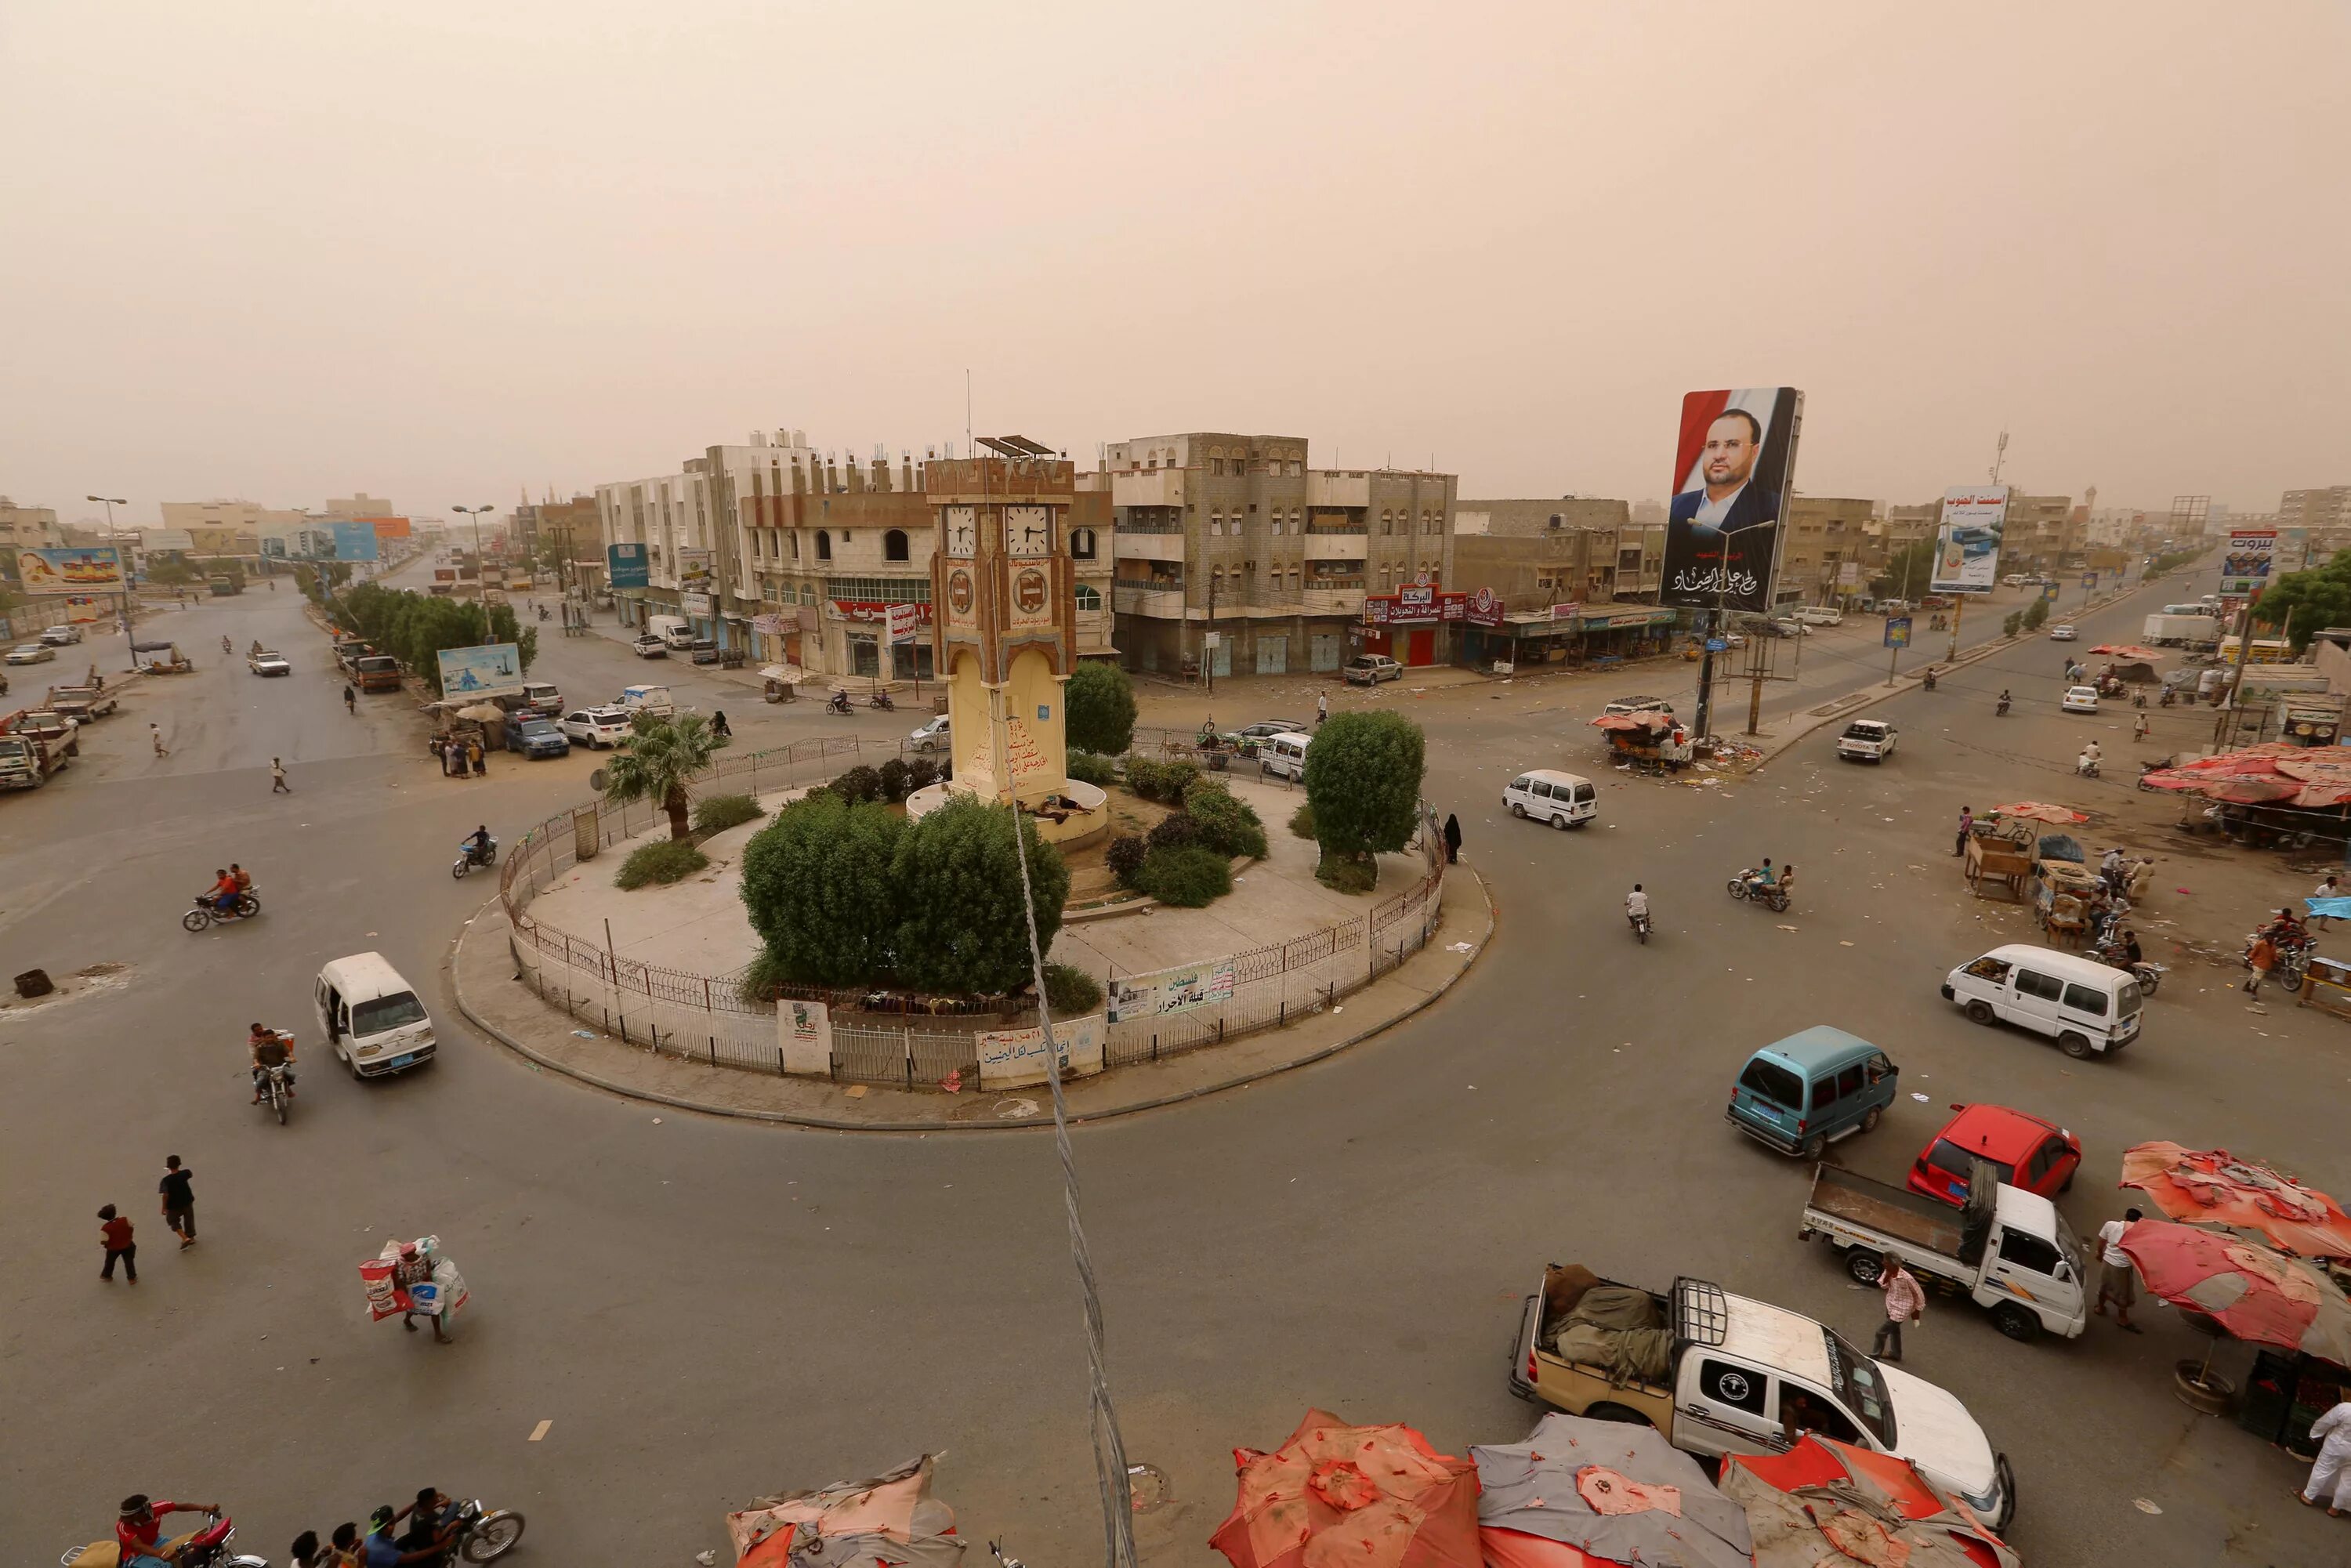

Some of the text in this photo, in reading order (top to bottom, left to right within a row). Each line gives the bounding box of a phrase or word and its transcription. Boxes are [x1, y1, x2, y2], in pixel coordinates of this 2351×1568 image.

[2232, 540, 2273, 550] بيروت
[1403, 590, 1430, 603] البركة
[892, 621, 915, 636] المركزية
[1168, 972, 1198, 991] فلسطين
